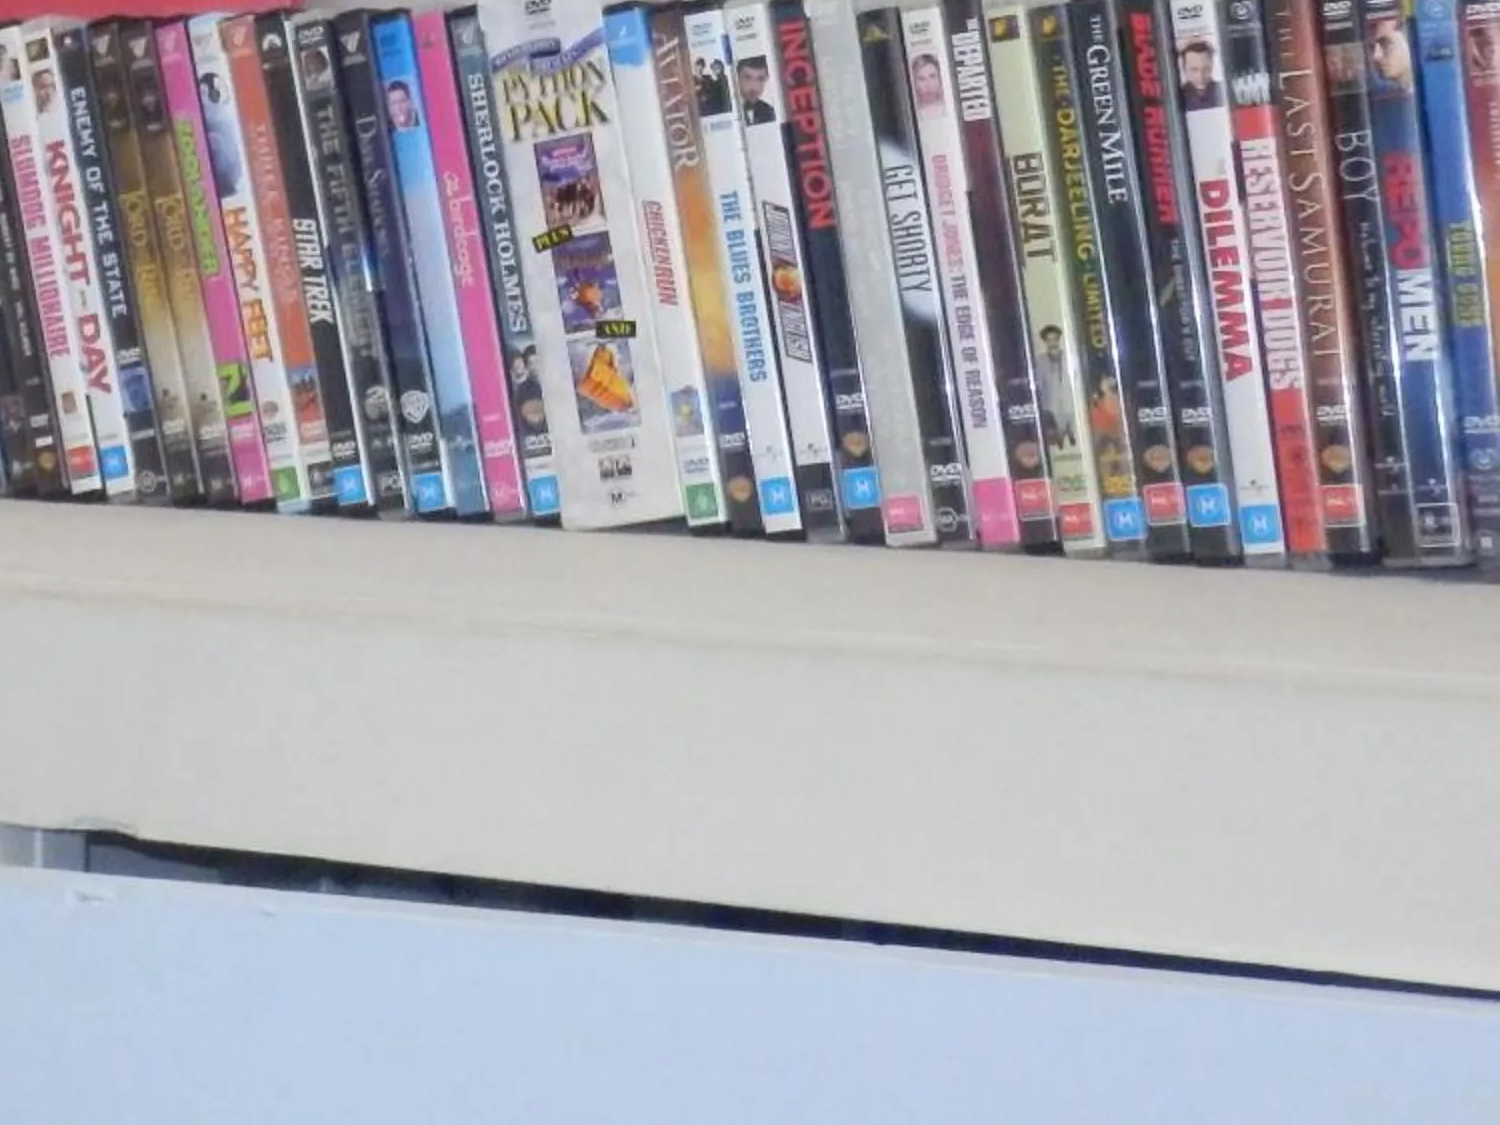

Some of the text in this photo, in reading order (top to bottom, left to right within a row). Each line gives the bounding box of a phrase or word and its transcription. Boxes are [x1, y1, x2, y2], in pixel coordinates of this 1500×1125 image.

[318, 104, 339, 157] THE
[509, 90, 610, 142] PACK
[654, 33, 700, 174] AVIATOR
[780, 17, 834, 231] INCEPTION
[953, 31, 993, 122] DEPARTED
[1086, 15, 1127, 205] THE GREEN MILE
[1278, 68, 1317, 162] LAST
[71, 85, 126, 318] ENEMY OF THE STATE
[470, 72, 526, 333] SHERLOCK HOLMES
[882, 163, 930, 293] GET SHORTY
[1058, 107, 1094, 260] DARJEELING
[1083, 274, 1104, 350] LIMITED
[1334, 127, 1380, 204] BOY
[10, 133, 68, 359] SLUMDOG MILLIONAIRE
[46, 139, 110, 394] KNIGHT DAY
[223, 205, 259, 293] HAPPY
[293, 217, 333, 324] STAR TREK
[720, 189, 766, 383] THE BLUES BROTHERS
[952, 275, 969, 301] THE
[1199, 178, 1254, 382] DILEMMA
[1241, 138, 1304, 390] RESERVOIR DOGS
[1290, 171, 1340, 358] SAMURAI
[1381, 152, 1438, 362] REPO MEN
[956, 306, 974, 340] EDGE
[961, 345, 978, 365] OF
[964, 370, 987, 428] REASON
